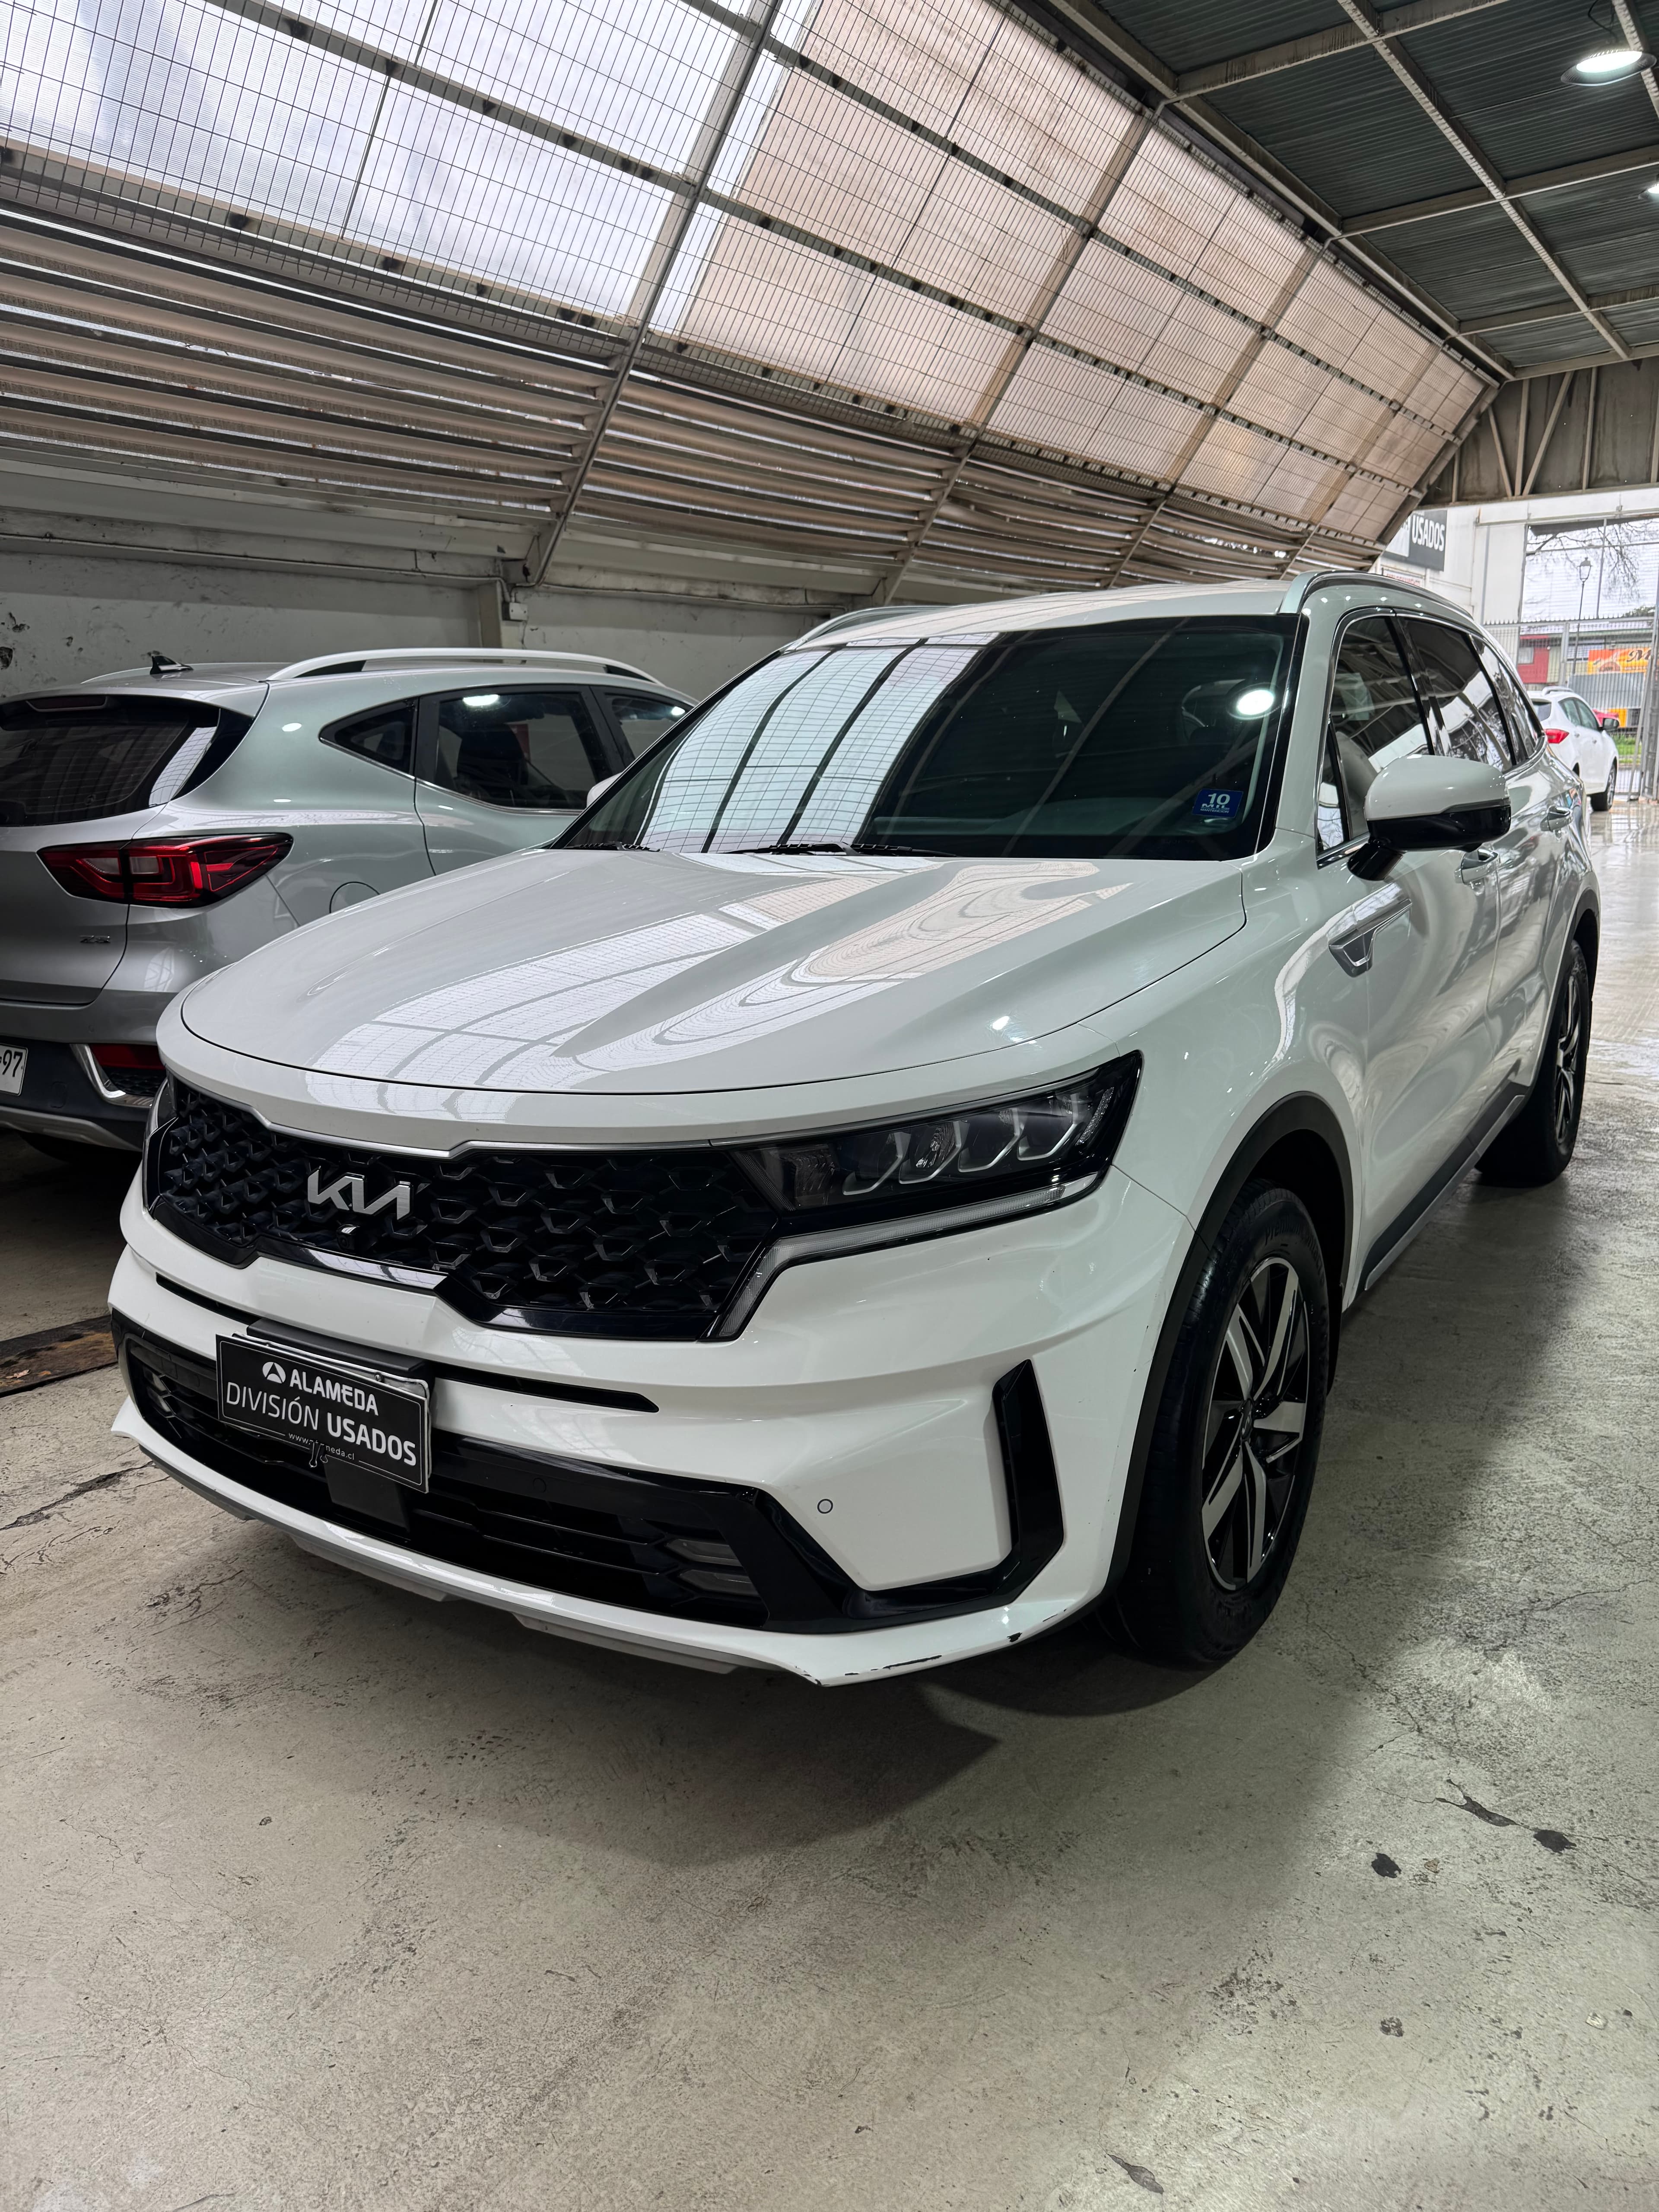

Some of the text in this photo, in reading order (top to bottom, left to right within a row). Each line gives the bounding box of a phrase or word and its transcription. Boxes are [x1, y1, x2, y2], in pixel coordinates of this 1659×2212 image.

[1412, 515, 1445, 551] USADOS
[1208, 793, 1230, 805] 10
[307, 1165, 410, 1220] KIA
[289, 1369, 379, 1416] ALAMEDA
[226, 1381, 416, 1466] DIVISIÓN USADOS
